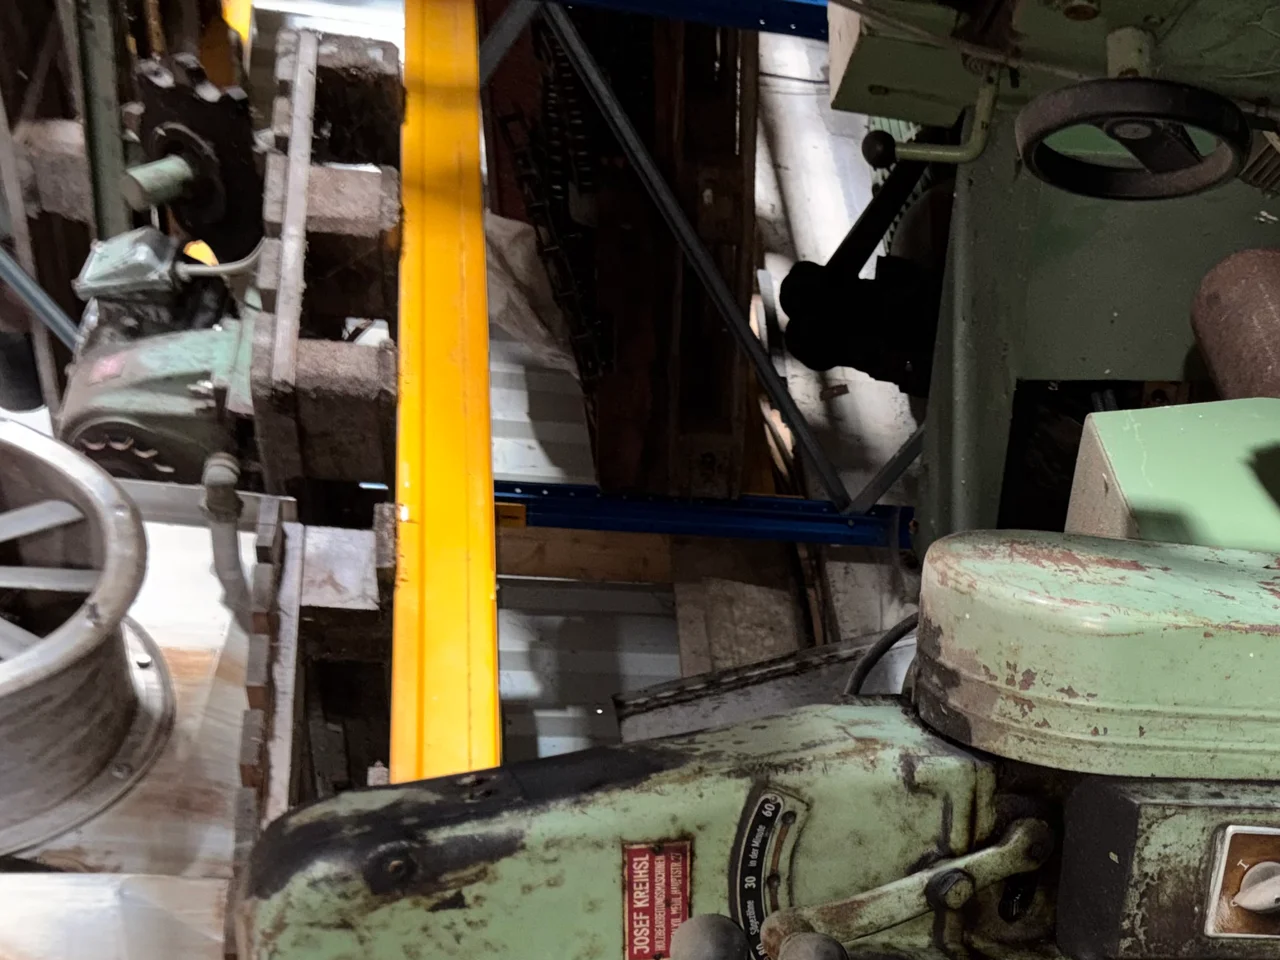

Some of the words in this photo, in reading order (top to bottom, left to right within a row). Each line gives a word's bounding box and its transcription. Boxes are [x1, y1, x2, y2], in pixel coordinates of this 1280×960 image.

[762, 803, 776, 818] 60
[751, 825, 766, 848] Minute
[749, 848, 759, 859] der
[633, 853, 650, 908] KREIHSL
[744, 876, 757, 889] 30
[633, 911, 650, 955] JOSEF
